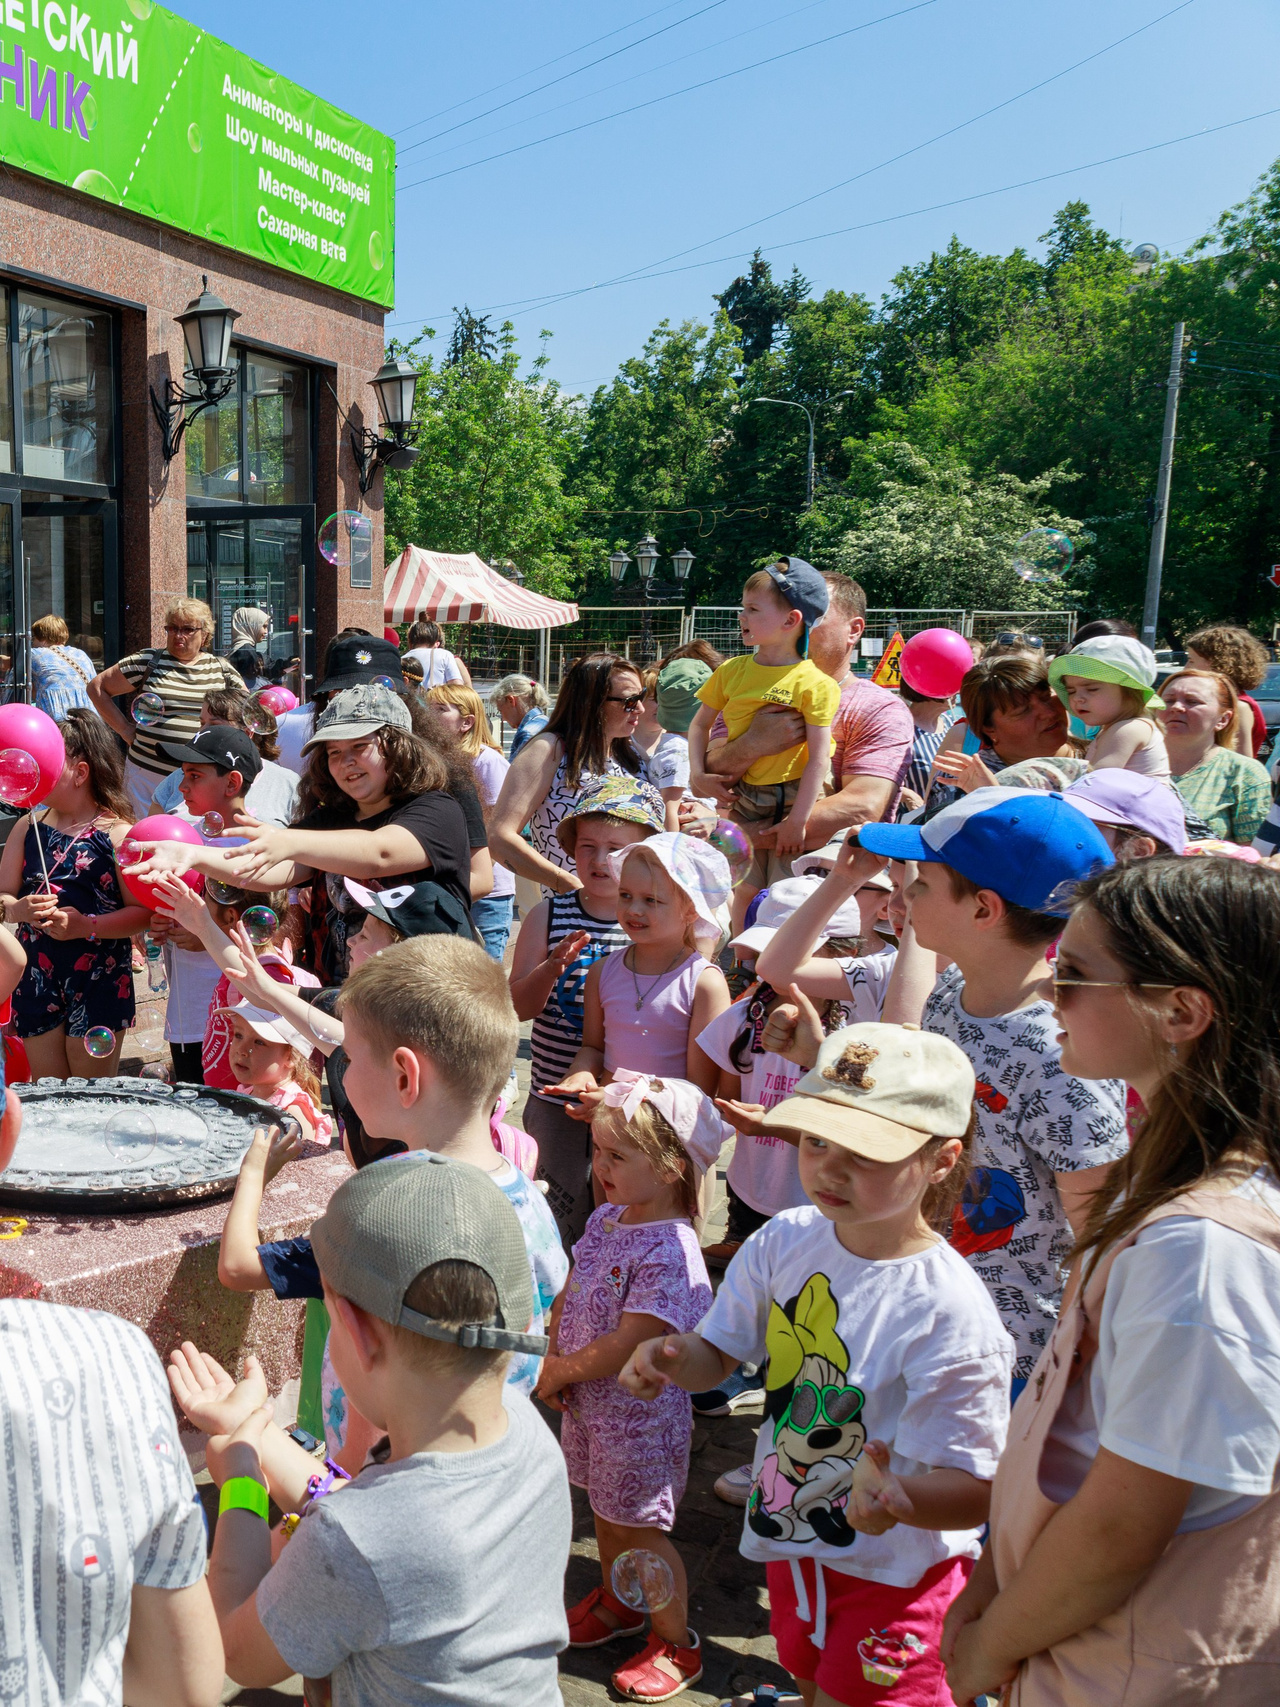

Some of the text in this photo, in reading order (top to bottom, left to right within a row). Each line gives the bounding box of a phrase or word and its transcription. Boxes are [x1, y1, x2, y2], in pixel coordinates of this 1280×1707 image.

[222, 73, 373, 174] Аниматоры и дискотека
[226, 113, 370, 206] Шоу мыльных пузырей
[258, 167, 346, 228] Мастер-класс
[257, 205, 347, 263] Сахарная вата
[771, 687, 791, 696] SKATE
[1061, 1092, 1090, 1112] MAN
[1066, 1078, 1098, 1109] SPIDER-
[1046, 1121, 1061, 1142] MAN
[1058, 1114, 1073, 1151] SPIDER-
[973, 1265, 1009, 1277] PIDER-
